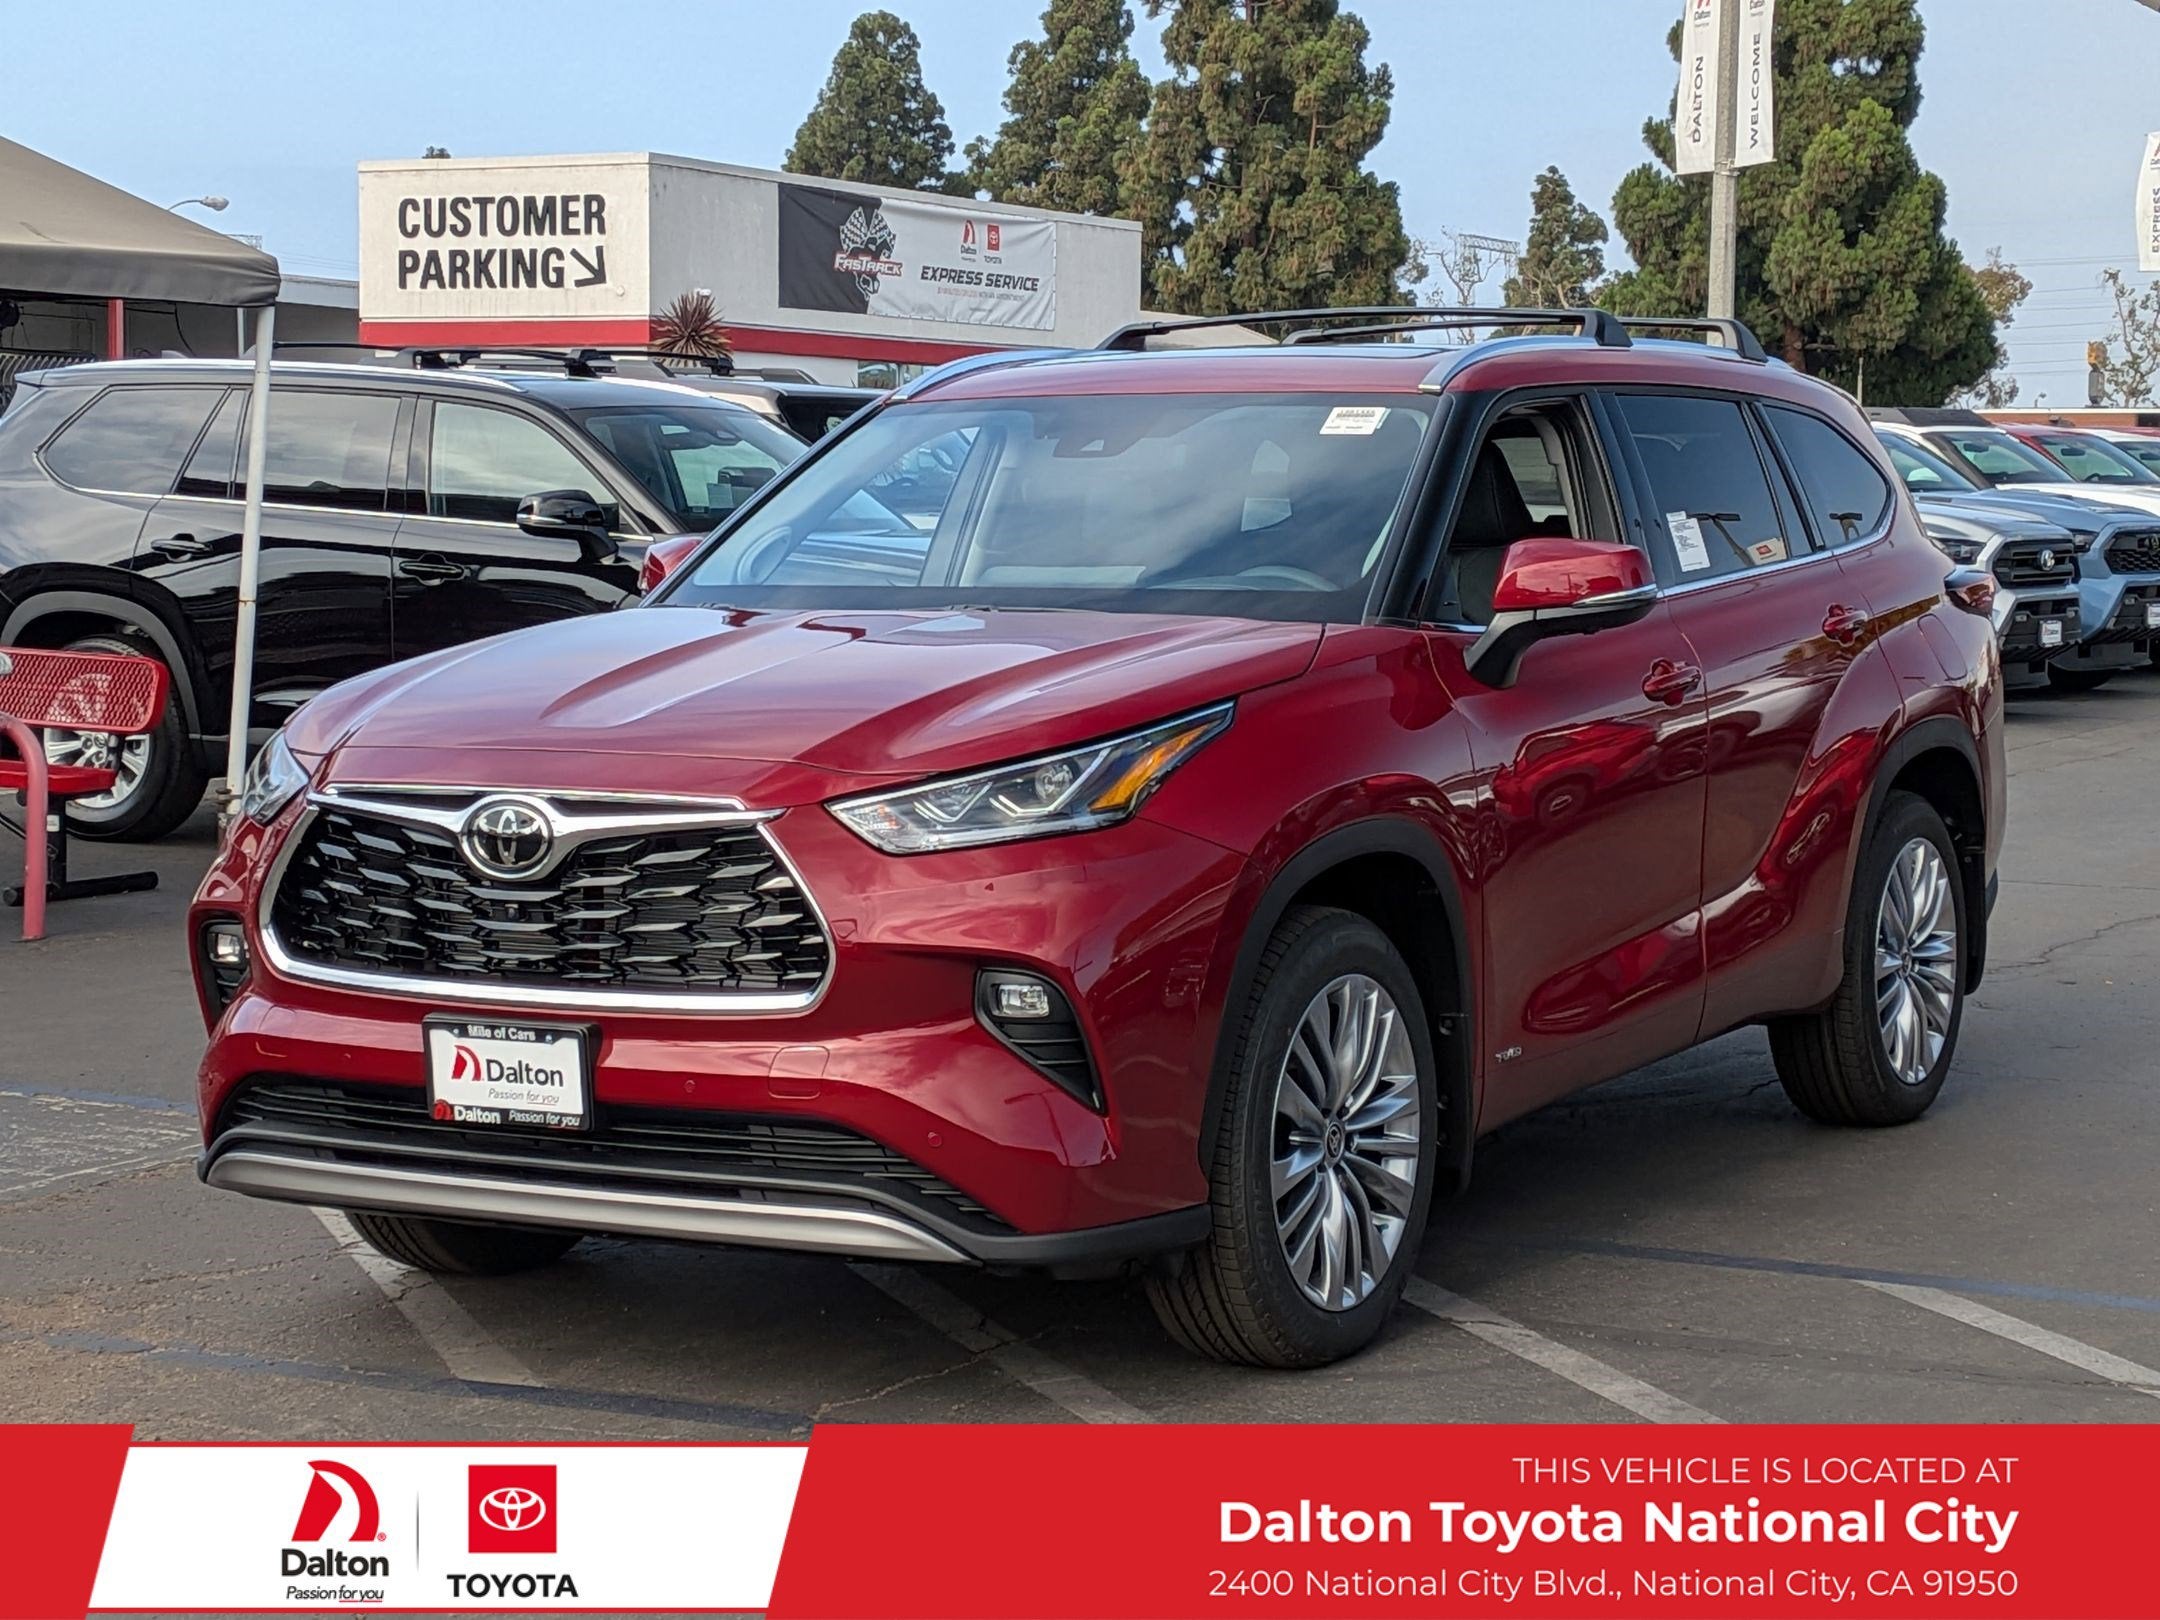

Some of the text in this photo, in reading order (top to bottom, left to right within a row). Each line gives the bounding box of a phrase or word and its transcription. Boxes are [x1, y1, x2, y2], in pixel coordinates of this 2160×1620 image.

[1692, 55, 1704, 143] DALTON
[1749, 33, 1761, 149] WELCOME
[398, 194, 606, 238] CUSTOMER
[398, 247, 565, 289] PARKING
[920, 265, 1041, 292] EXPRESS SERVICE
[467, 1024, 536, 1041] Mile of Cars
[486, 1058, 564, 1087] Dalton
[488, 1087, 560, 1104] Passion for you
[454, 1106, 580, 1128] Dalton Passion for you
